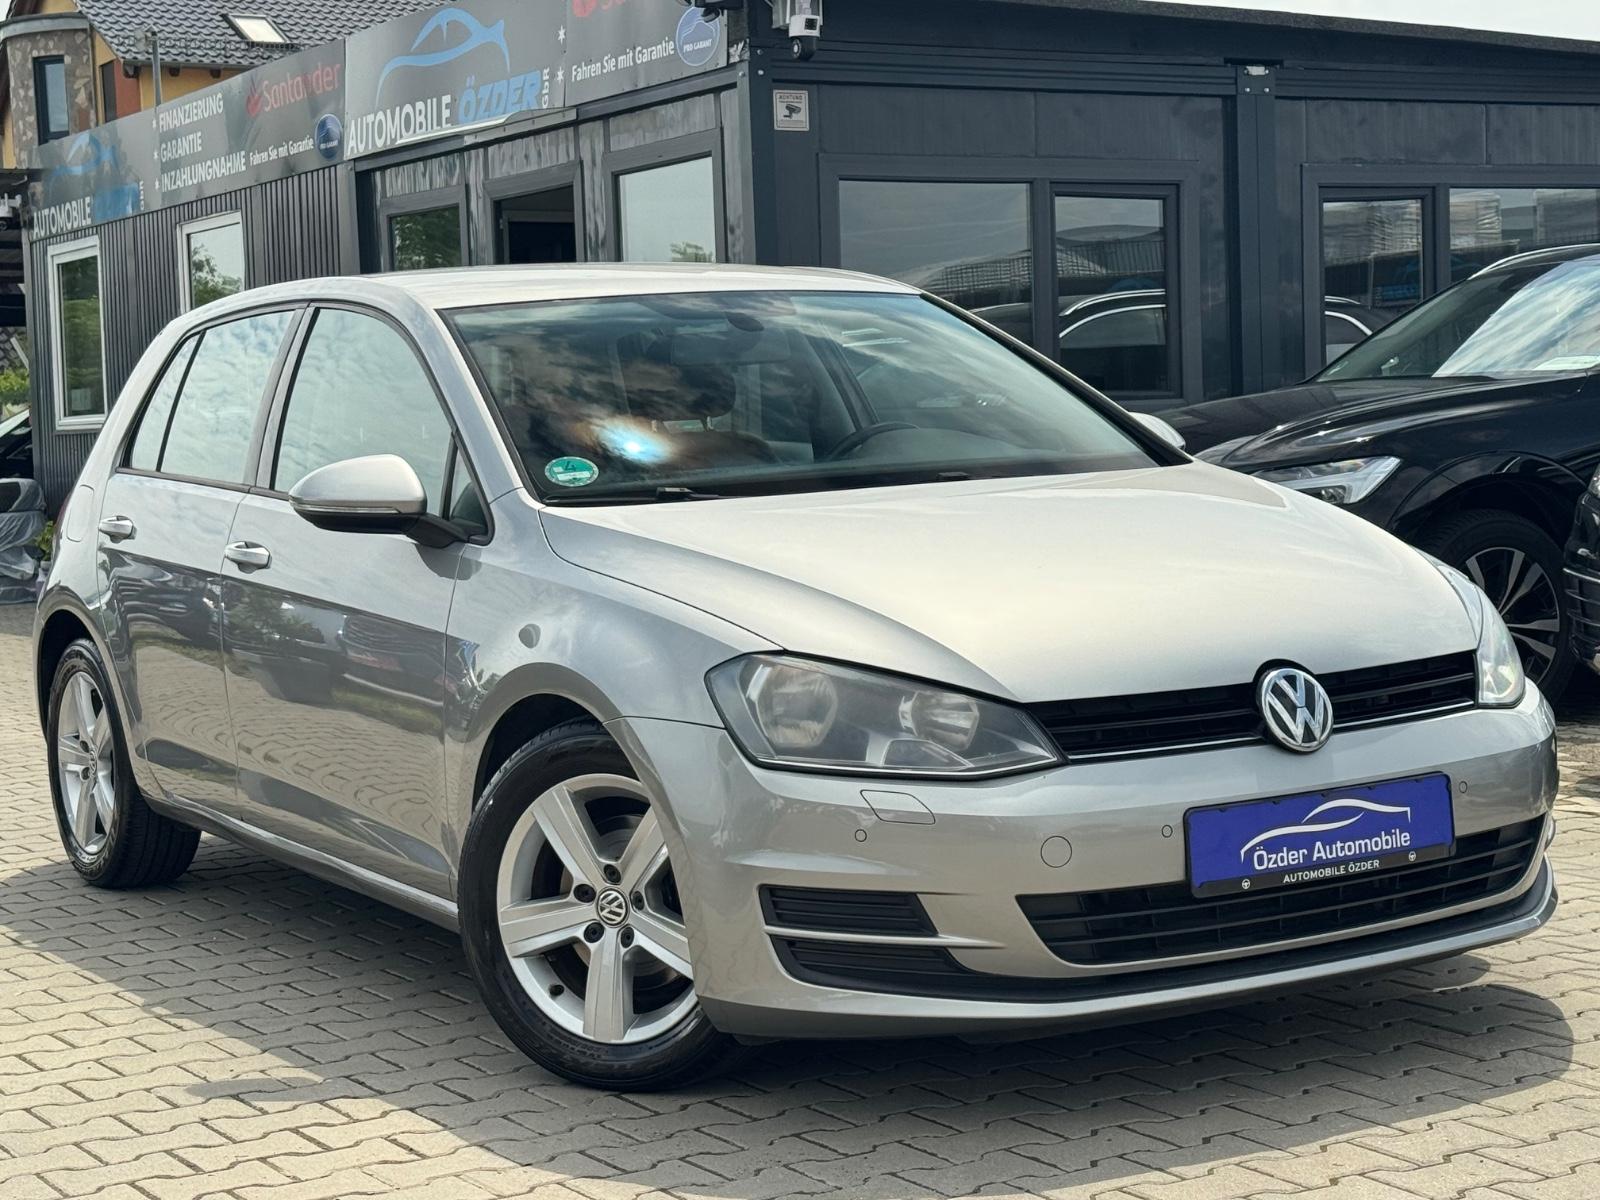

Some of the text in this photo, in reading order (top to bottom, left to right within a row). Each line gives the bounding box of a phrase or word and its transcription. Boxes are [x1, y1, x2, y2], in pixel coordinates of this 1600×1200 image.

[571, 36, 675, 82] Fahren Sie mit Garantie
[262, 62, 340, 112] Santander
[159, 92, 224, 133] FINANZIERUNG
[347, 67, 550, 155] AUTOMOBILE ÖZDER GbR
[160, 131, 202, 163] GARANTIE
[249, 147, 268, 167] Fahren
[268, 145, 277, 160] Sie
[288, 134, 314, 155] Garantie
[161, 150, 246, 193] INZAHLUNGNAHME
[33, 196, 92, 240] AUTOMOBILE
[1253, 828, 1411, 871] Özder Automobile
[1283, 859, 1380, 884] AUTOMOBILE ÖZDER
